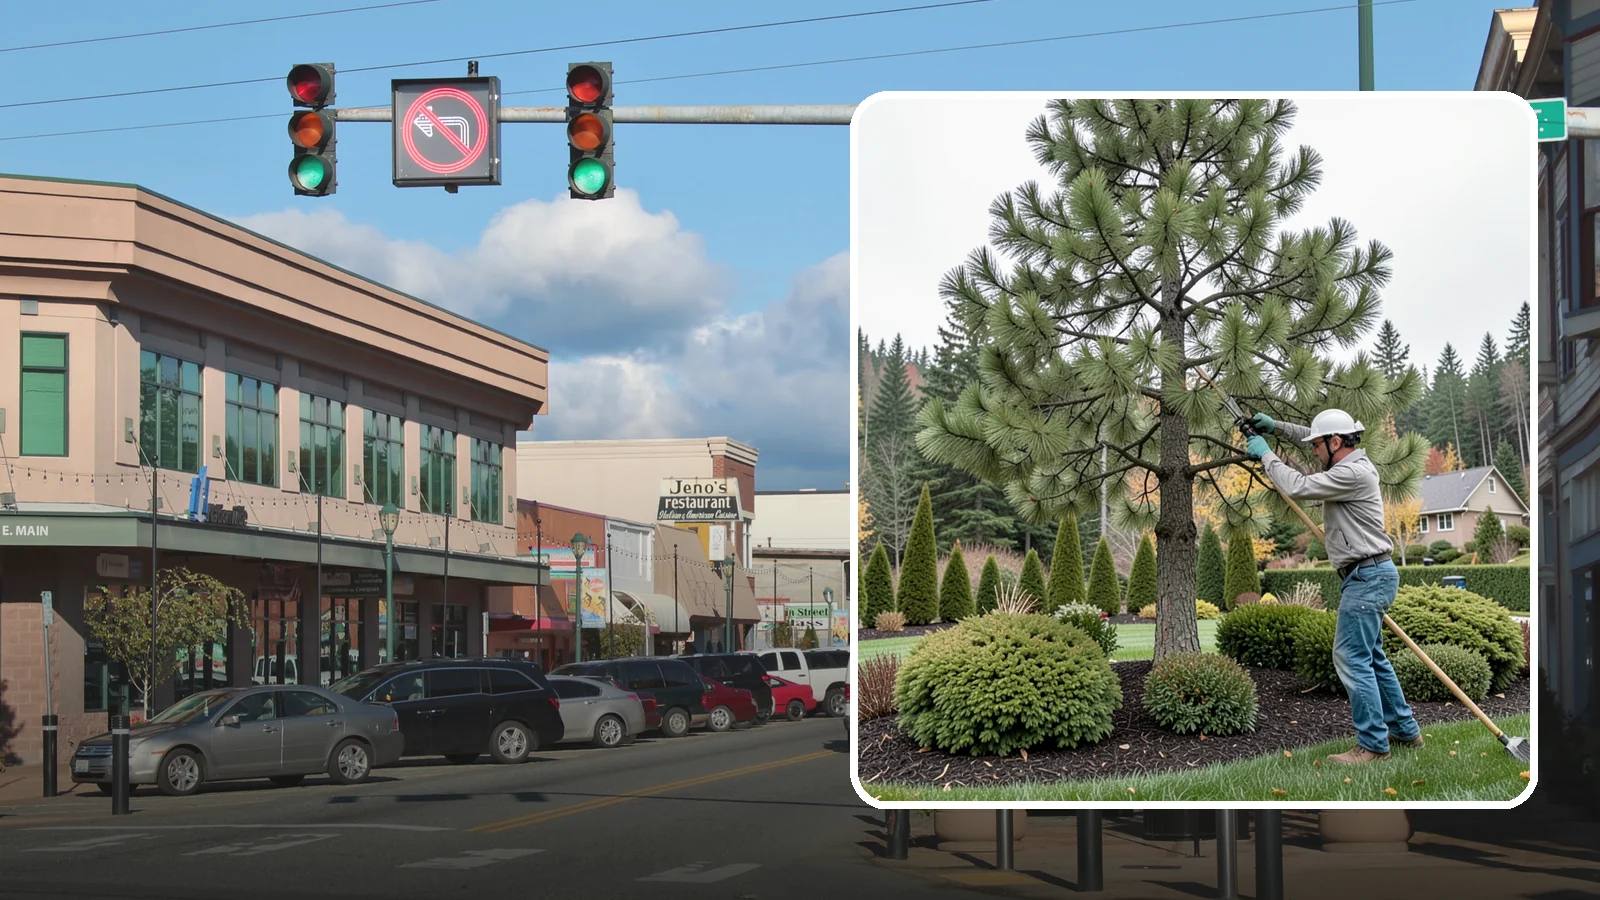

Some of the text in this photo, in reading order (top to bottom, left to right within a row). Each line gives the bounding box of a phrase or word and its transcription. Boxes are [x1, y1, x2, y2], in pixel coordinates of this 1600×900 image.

[670, 480, 727, 495] Jeno's
[665, 496, 731, 509] restaurant
[658, 509, 681, 519] Italian
[686, 509, 714, 519] American
[715, 509, 737, 519] Cuisine
[2, 525, 49, 536] E. MAIN
[797, 607, 828, 617] Street
